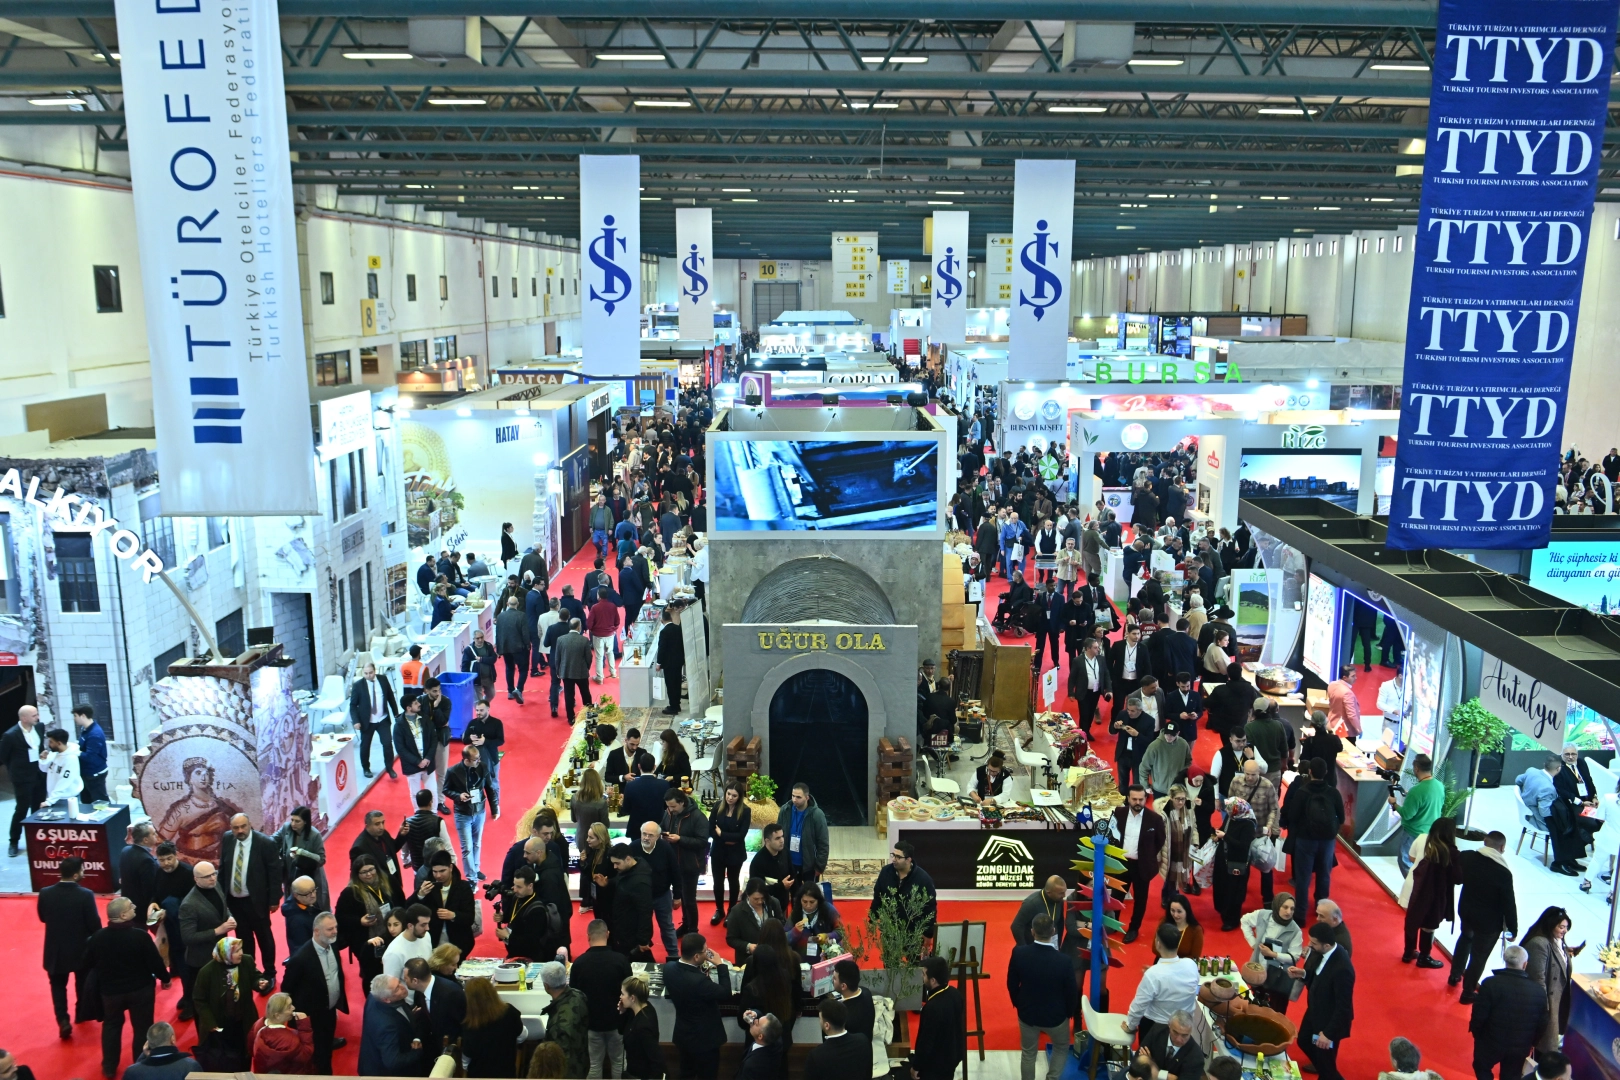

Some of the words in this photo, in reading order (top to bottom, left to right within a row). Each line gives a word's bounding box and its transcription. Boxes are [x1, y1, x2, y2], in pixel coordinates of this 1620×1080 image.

[1449, 23, 1481, 31] TÜRKİYE
[1484, 24, 1513, 33] TURİZM
[235, 7, 259, 117] Federati
[1446, 35, 1603, 83] TTYD
[222, 0, 242, 138] Federasyo
[1443, 85, 1474, 93] TURKISH
[1475, 86, 1509, 94] TOURISM
[1510, 87, 1550, 95] INVESTORS
[1439, 116, 1472, 125] TÜRKİYE
[1437, 128, 1592, 174] TTYD
[1433, 176, 1465, 185] TURKISH
[1465, 178, 1500, 186] TOURISM
[250, 137, 271, 255] Hoteliers
[234, 153, 255, 263] Otelciler
[1430, 207, 1462, 216] TÜRKİYE
[1463, 209, 1494, 217] TURİZM
[1428, 218, 1581, 264] TTYD
[761, 264, 775, 275] 10
[1426, 266, 1455, 274] TURKISH
[1456, 268, 1490, 276] TOURISM
[1423, 296, 1452, 304] TÜRKİYE
[1454, 298, 1484, 306] TURİZM
[246, 275, 264, 362] Türkiye
[261, 272, 280, 361] Turkish
[366, 306, 373, 328] 8
[1421, 307, 1569, 352] TTYD
[1416, 353, 1447, 362] TURKISH
[1448, 355, 1480, 363] TOURISM
[1095, 362, 1243, 385] BURSA
[1412, 383, 1443, 391] TÜRKİYE
[1410, 393, 1557, 438] TTYD
[495, 424, 520, 444] HATAY
[1039, 424, 1063, 433] KEŞFET
[1282, 432, 1326, 448] Rize
[1408, 439, 1435, 447] TURKISH
[1437, 441, 1469, 449] TOURISM
[1406, 467, 1432, 475] TÜRKİYE
[1435, 469, 1463, 477] TURİZM
[1521, 470, 1547, 478] DERNEĞİ
[1402, 478, 1543, 521] TTYD
[0, 467, 164, 584] ALKIYOR
[1401, 522, 1428, 530] TURKISH
[1429, 524, 1460, 532] TOURISM
[1549, 552, 1565, 564] Hiç
[1567, 552, 1607, 567] şüphesiz
[1609, 552, 1618, 563] ki
[1546, 568, 1591, 582] dünyanın
[1594, 570, 1605, 578] en
[1607, 568, 1620, 582] gü
[758, 627, 829, 650] UĞUR
[835, 633, 886, 650] OLA
[1482, 658, 1561, 739] Antalya
[36, 829, 47, 840] 6
[48, 828, 98, 844] ŞUBAT
[33, 860, 106, 870] UNUDIK
[976, 865, 1034, 874] ZONGULDAK
